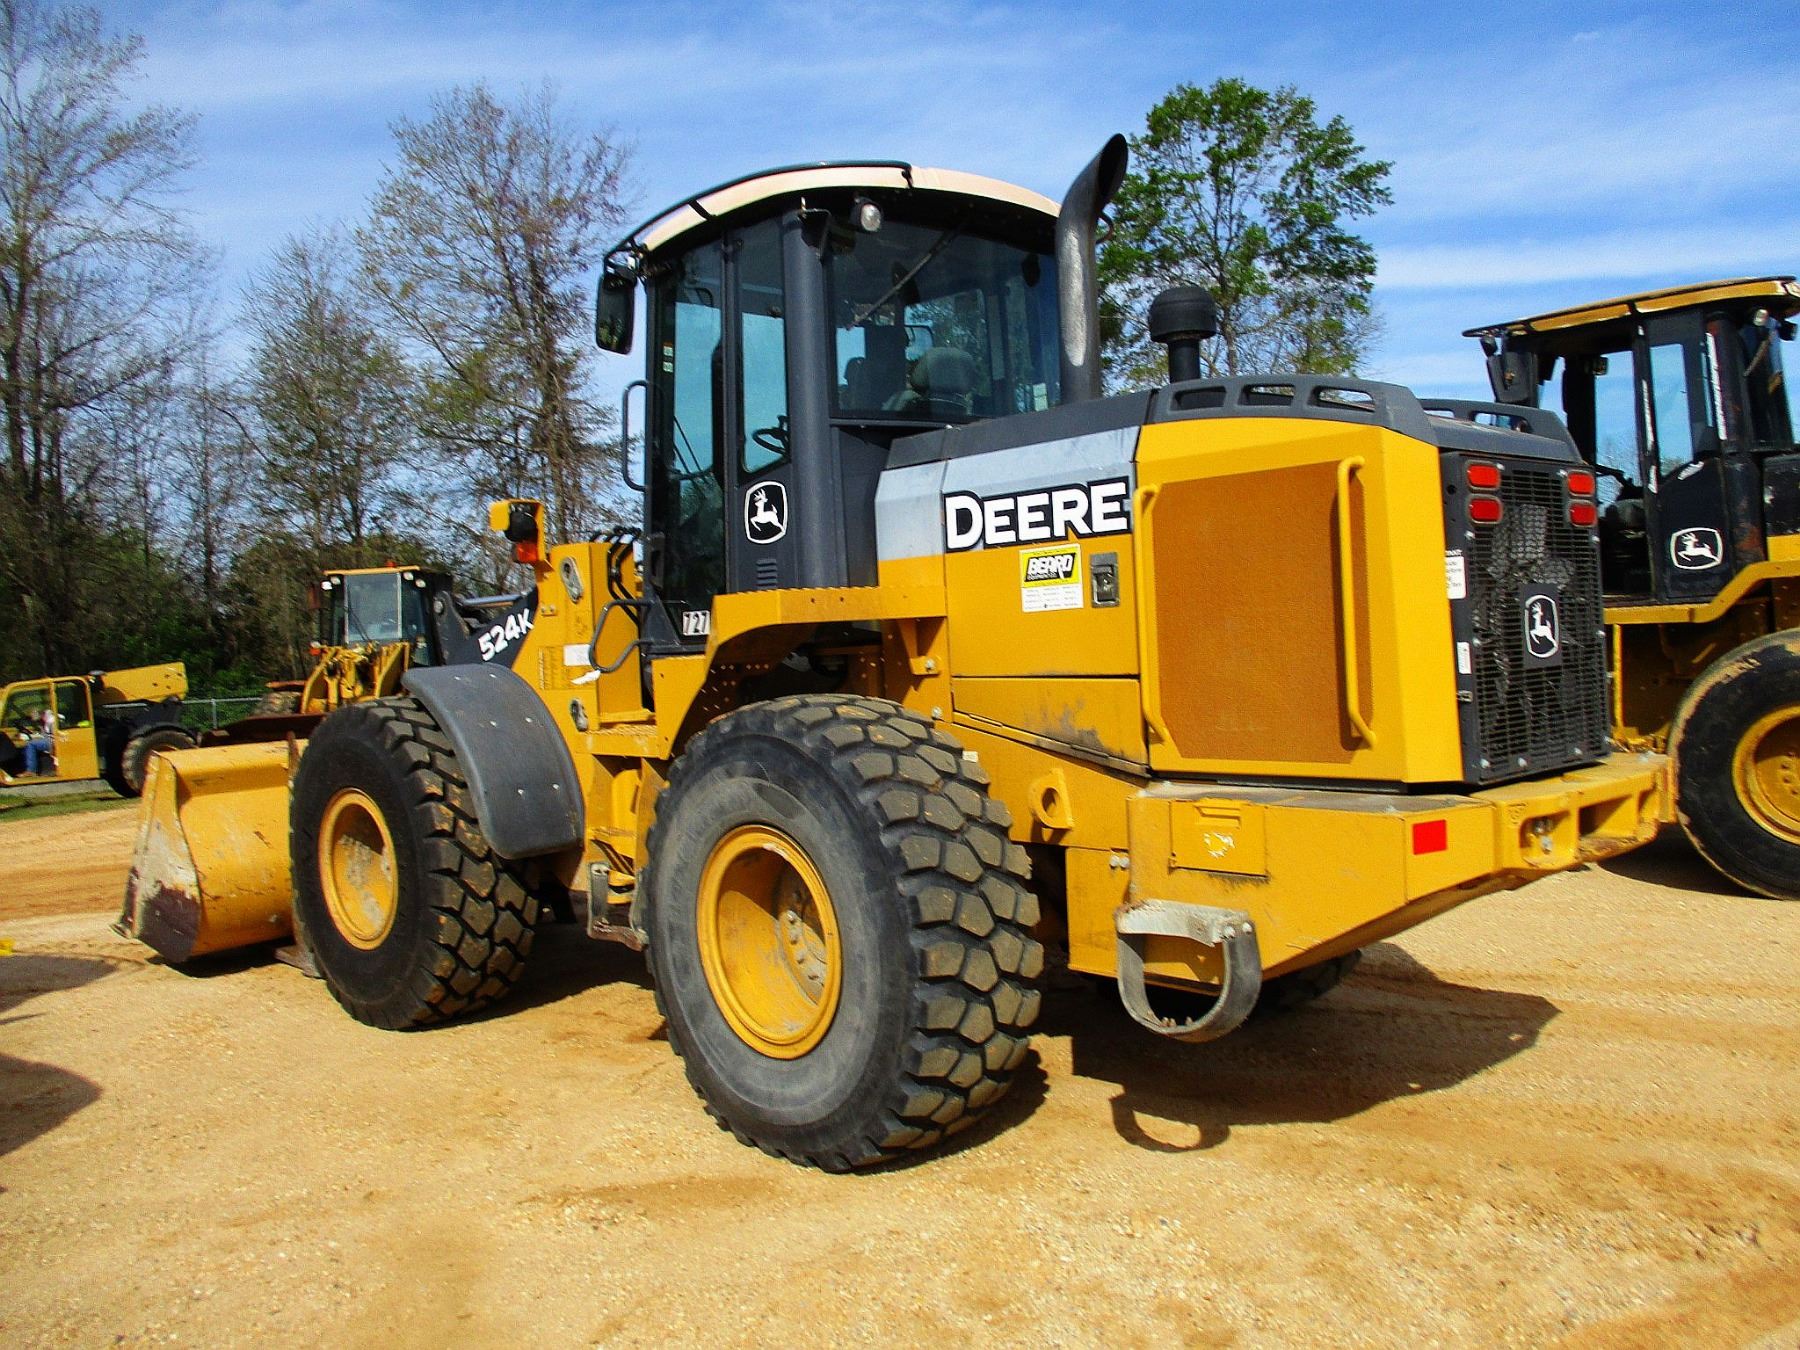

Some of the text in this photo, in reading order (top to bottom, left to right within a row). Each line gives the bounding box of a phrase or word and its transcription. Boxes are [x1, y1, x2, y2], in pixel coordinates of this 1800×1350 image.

[945, 482, 1128, 549] DEERE
[1027, 554, 1074, 580] BEARD
[478, 608, 535, 661] 524K
